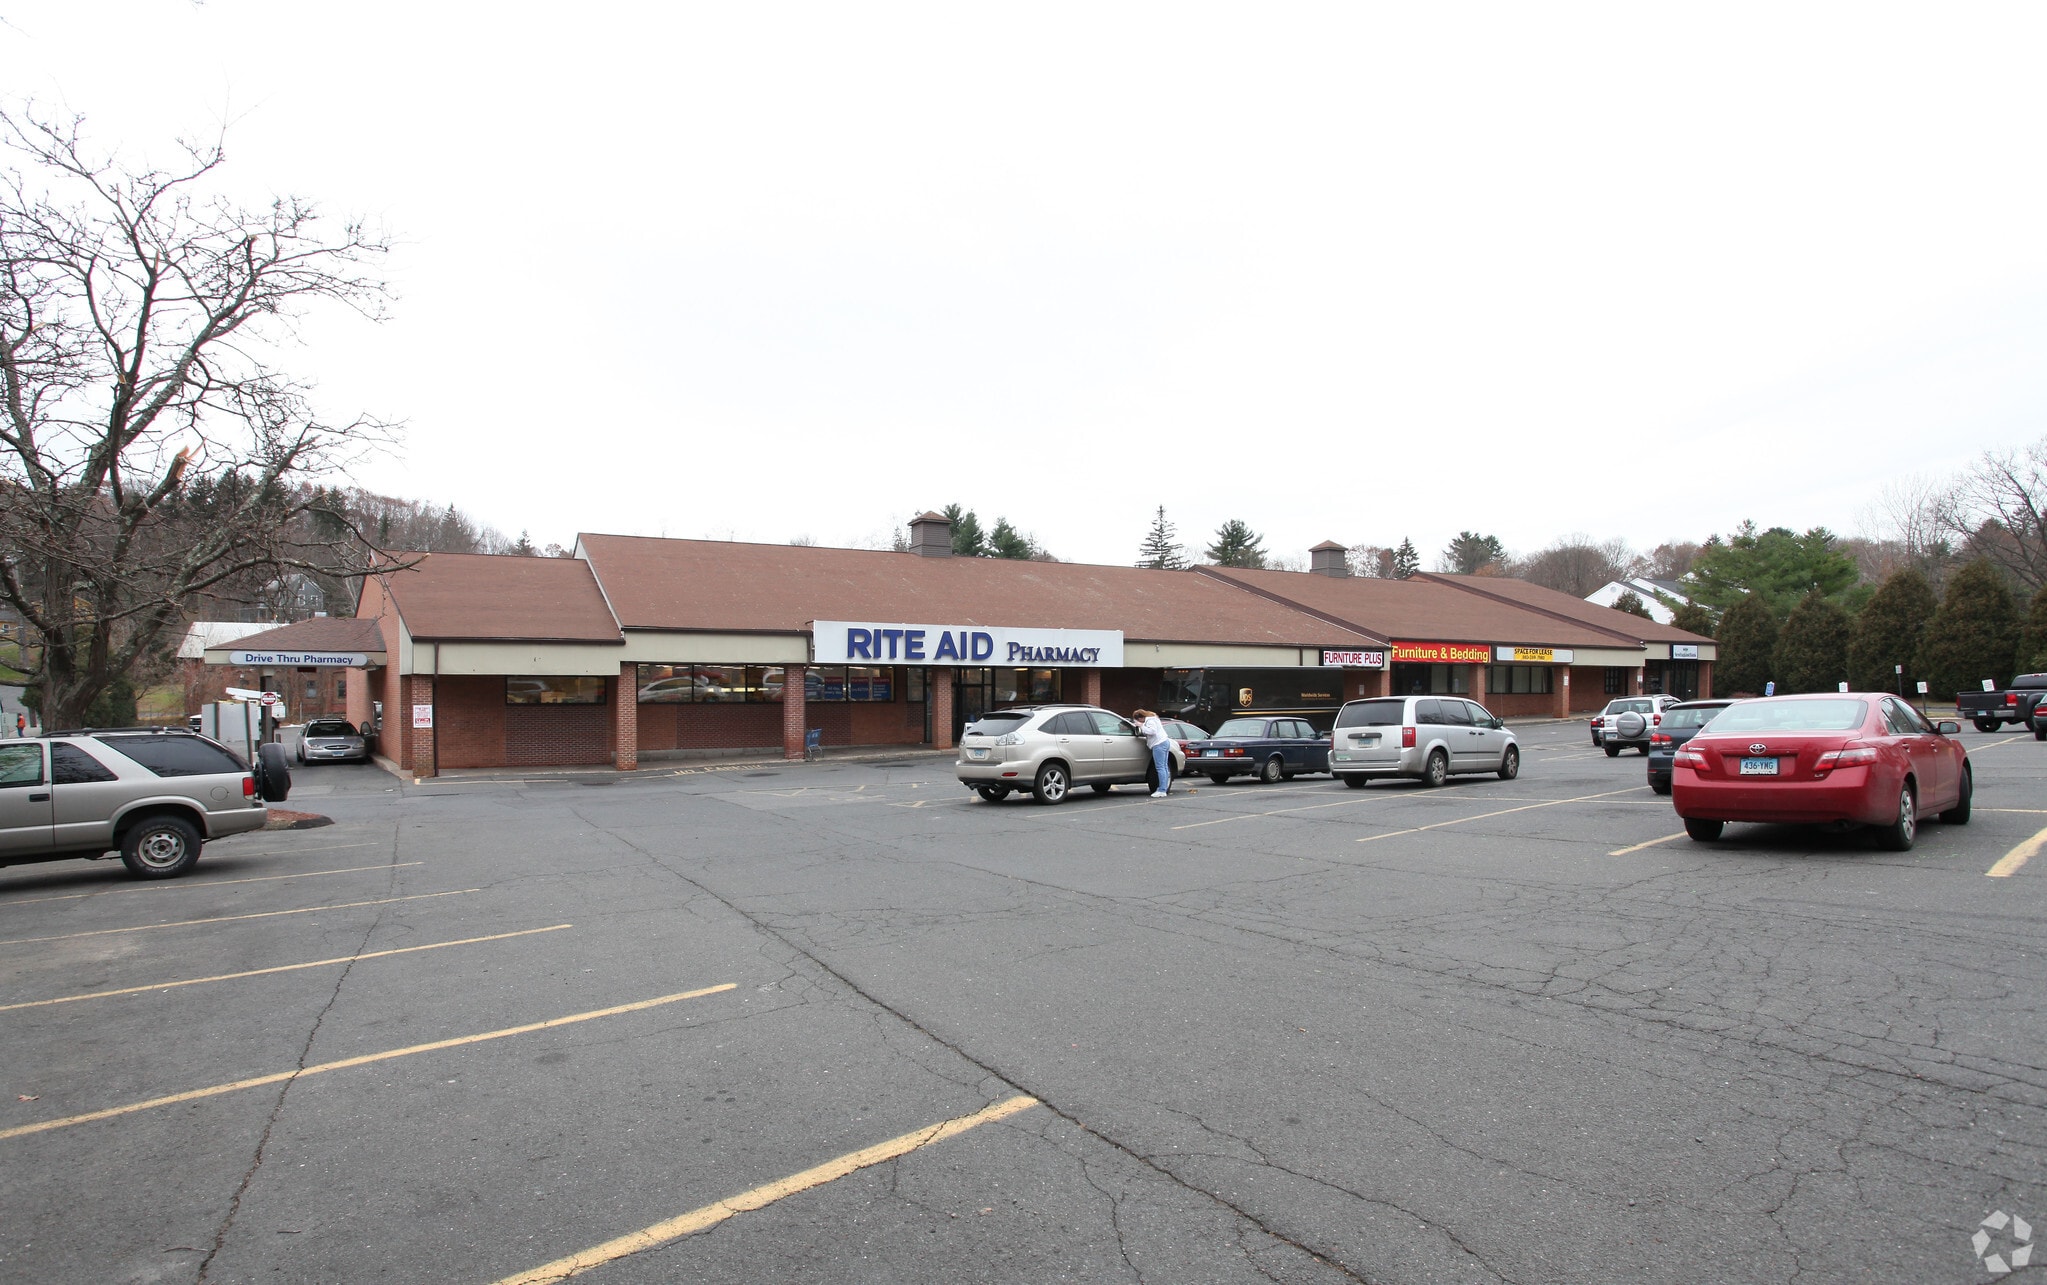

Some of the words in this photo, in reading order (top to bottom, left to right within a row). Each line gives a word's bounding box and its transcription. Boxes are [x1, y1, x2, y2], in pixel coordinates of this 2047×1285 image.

[847, 627, 926, 660] RITE
[933, 630, 994, 661] AID
[1324, 652, 1362, 664] FURNITURE
[1364, 653, 1382, 665] PLUS
[1391, 645, 1437, 659] Furniture
[1440, 647, 1448, 659] &
[1450, 647, 1489, 662] Bedding
[1539, 648, 1553, 656] LEASE
[245, 653, 273, 663] Drive
[276, 654, 300, 663] Thru
[303, 655, 354, 665] Pharmacy
